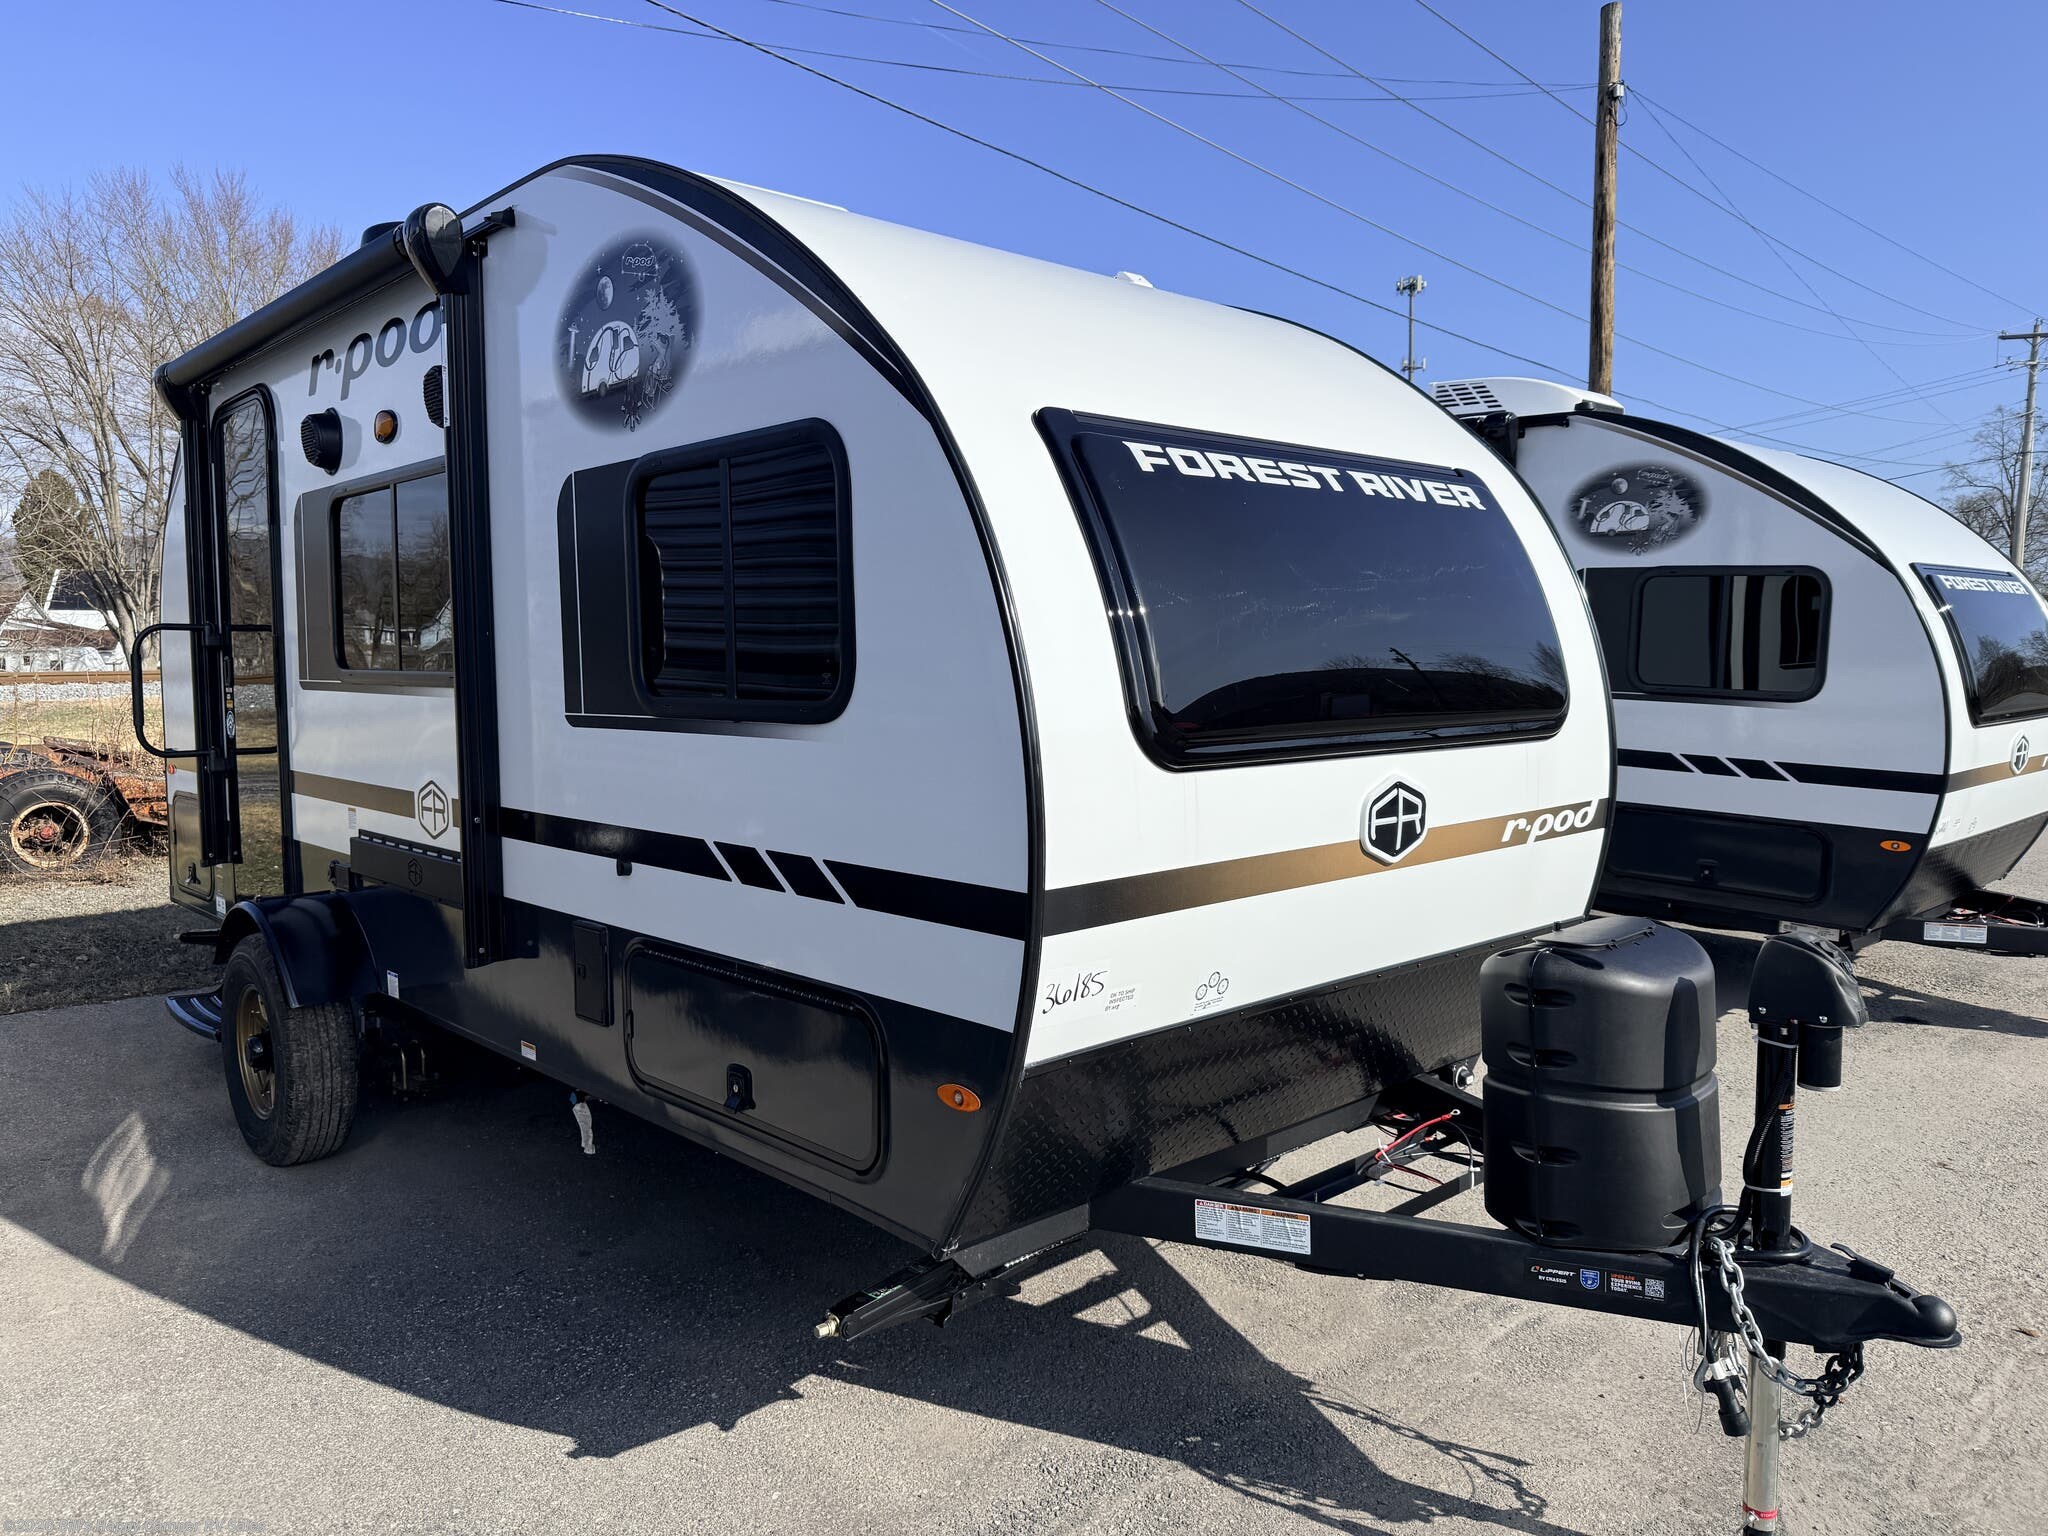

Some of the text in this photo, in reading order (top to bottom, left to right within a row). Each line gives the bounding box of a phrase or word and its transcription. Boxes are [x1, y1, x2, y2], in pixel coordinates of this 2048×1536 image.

[1121, 440, 1487, 511] FOREST RIVER
[1936, 574, 2030, 596] FOREST RIVER
[1042, 970, 1108, 1015] 36185
[1539, 1267, 1577, 1277] LIPPERT
